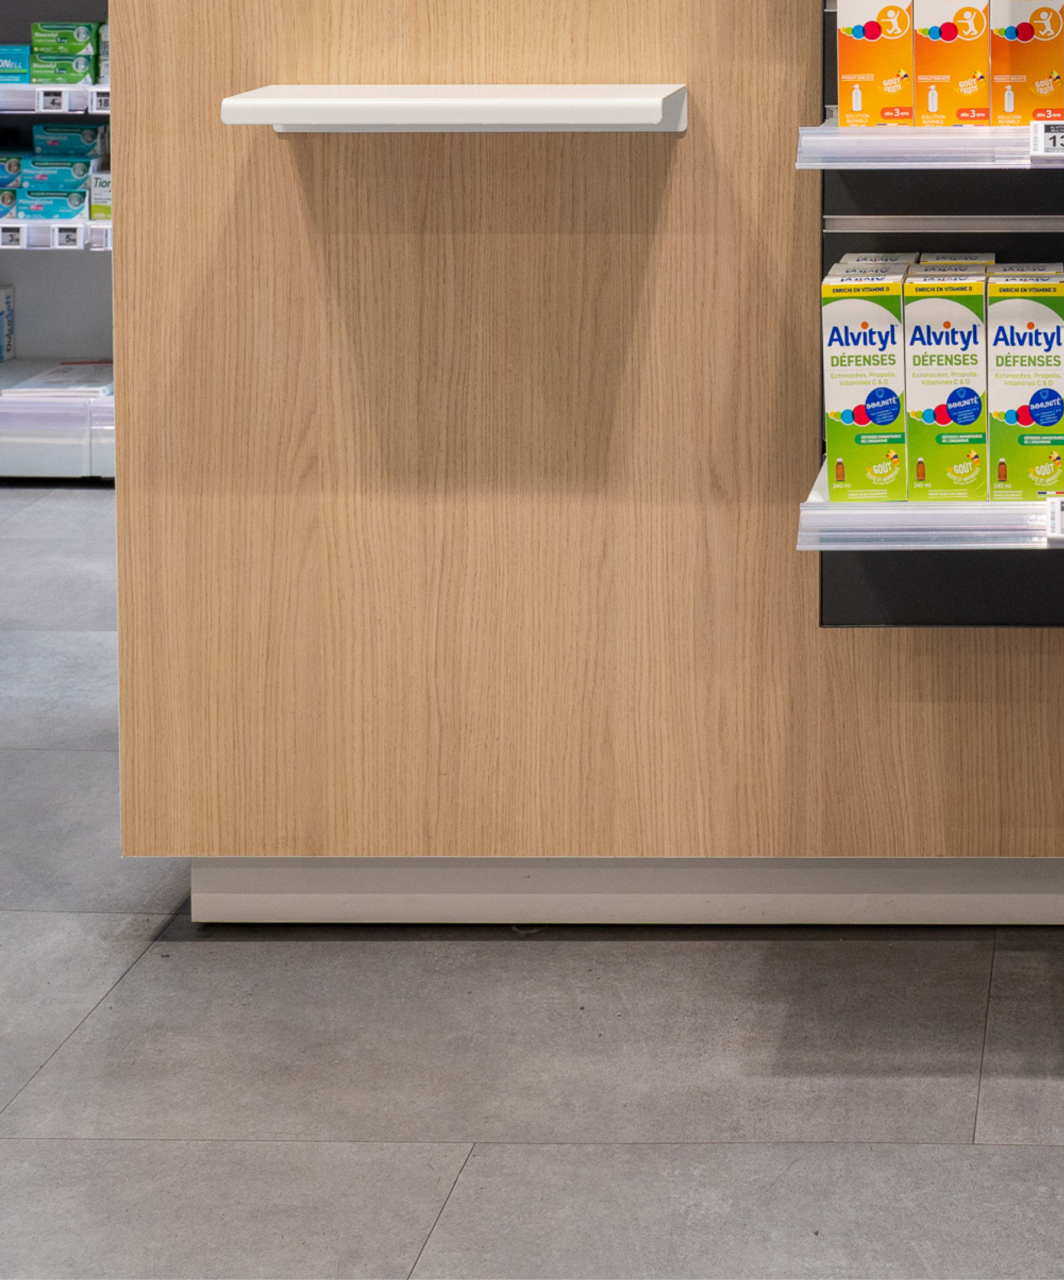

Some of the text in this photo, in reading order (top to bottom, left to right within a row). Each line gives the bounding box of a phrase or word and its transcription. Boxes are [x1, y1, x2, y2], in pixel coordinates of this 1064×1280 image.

[882, 76, 902, 87] GOÛT
[894, 108, 900, 117] 3
[832, 286, 852, 294] ENRICHI
[827, 321, 898, 352] Alvityl
[909, 320, 979, 352] Alvityl
[992, 321, 1063, 353] Alvityl
[830, 352, 897, 368] DÉFENSES
[912, 351, 979, 368] DÉFENSES
[995, 352, 1062, 368] DÉFENSES
[830, 372, 897, 381] Echinacées, Propolis,
[866, 395, 898, 410] IMMUNITÉ
[872, 461, 893, 475] GOÛT
